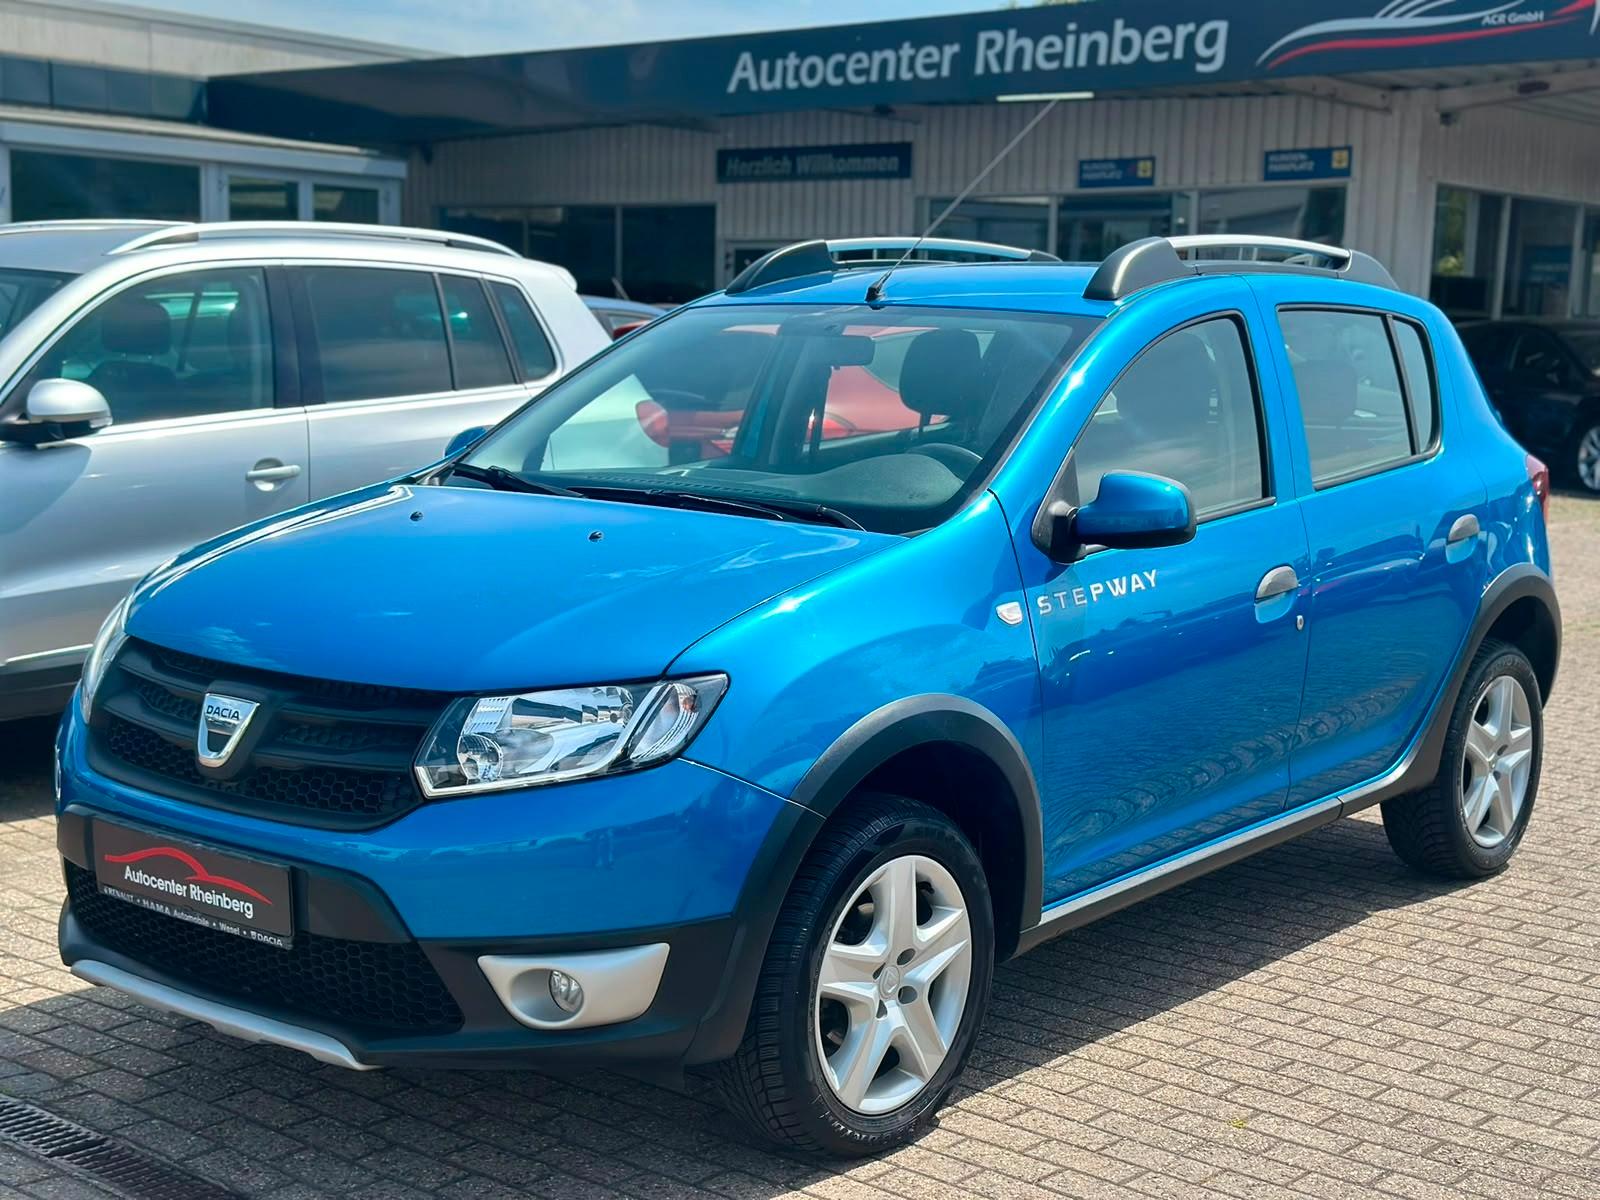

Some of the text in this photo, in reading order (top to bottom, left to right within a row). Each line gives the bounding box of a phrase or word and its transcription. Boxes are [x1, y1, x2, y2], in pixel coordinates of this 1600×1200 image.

[1481, 10, 1545, 26] ACR GmbH
[727, 18, 1229, 94] Autocenter Rheinberg
[795, 152, 899, 176] Willkommen
[1037, 569, 1157, 615] STEPWAY
[206, 705, 240, 720] DACIA
[124, 865, 254, 919] Autocenter Rheinberg
[142, 899, 171, 916] HAMA
[173, 909, 210, 928] Automobile
[257, 932, 283, 947] DACIA
